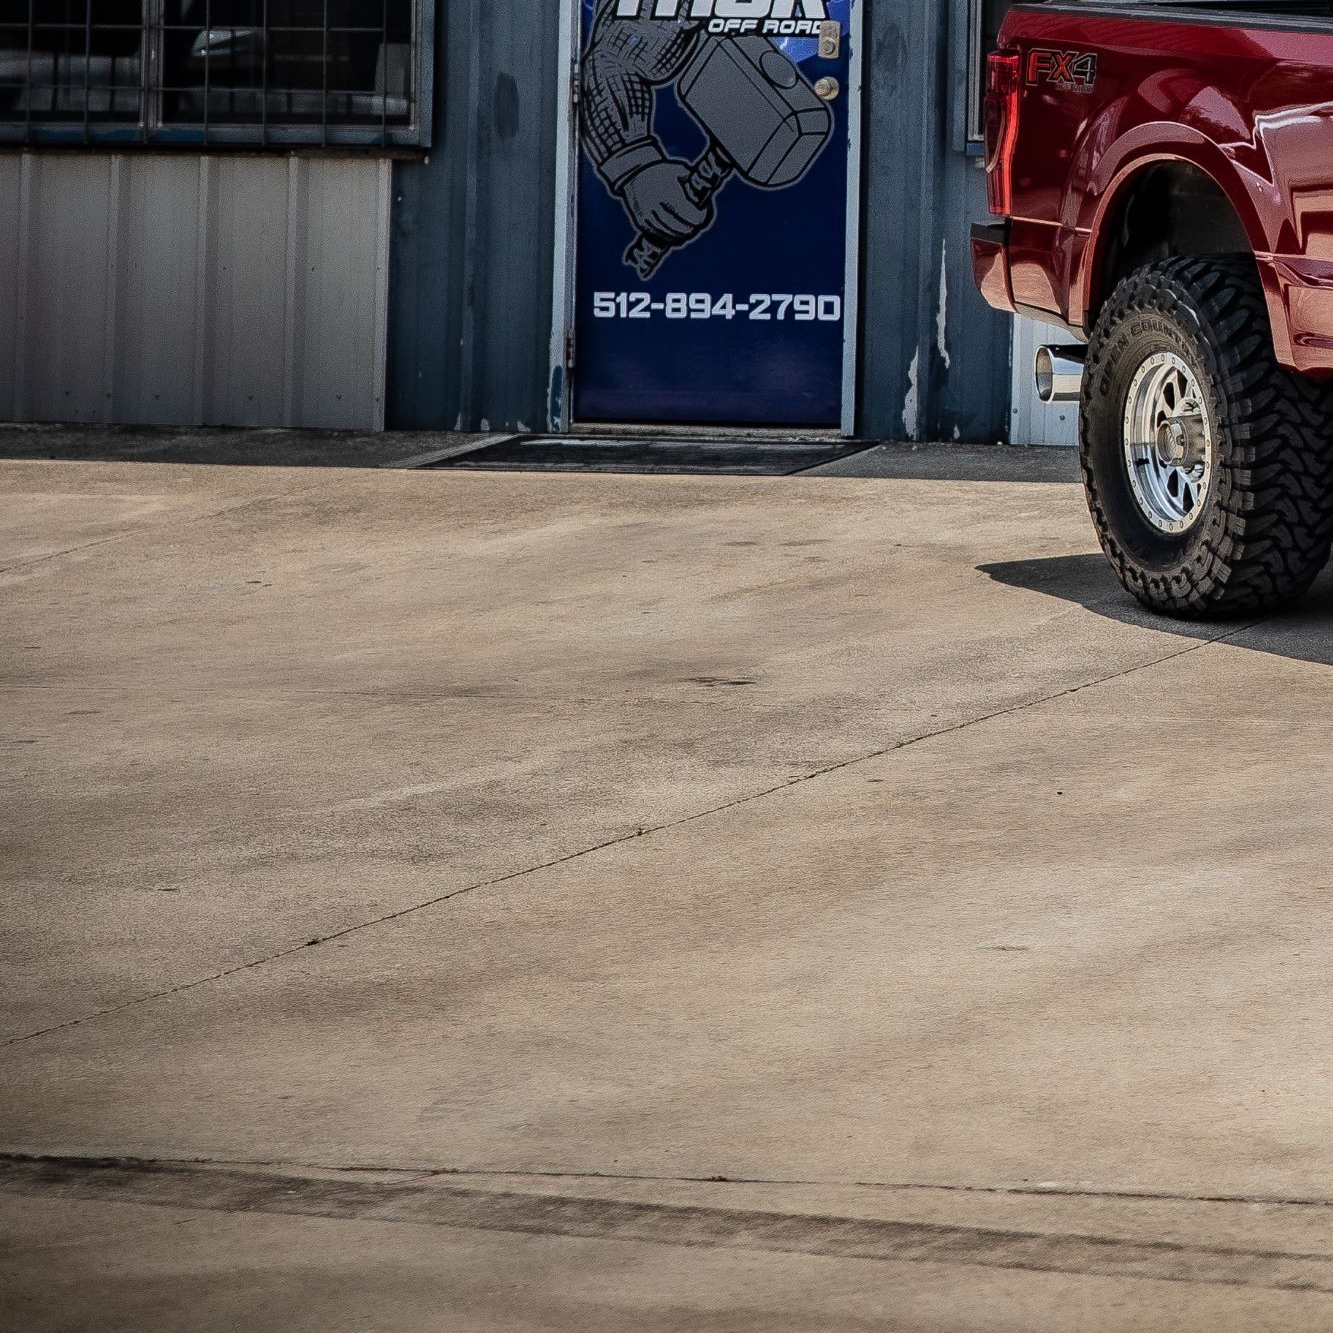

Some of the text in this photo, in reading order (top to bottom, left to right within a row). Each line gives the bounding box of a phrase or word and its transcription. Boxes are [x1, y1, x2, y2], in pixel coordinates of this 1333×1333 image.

[708, 19, 759, 34] OFF
[1025, 48, 1098, 86] FX4
[593, 291, 841, 321] 512-894-2790
